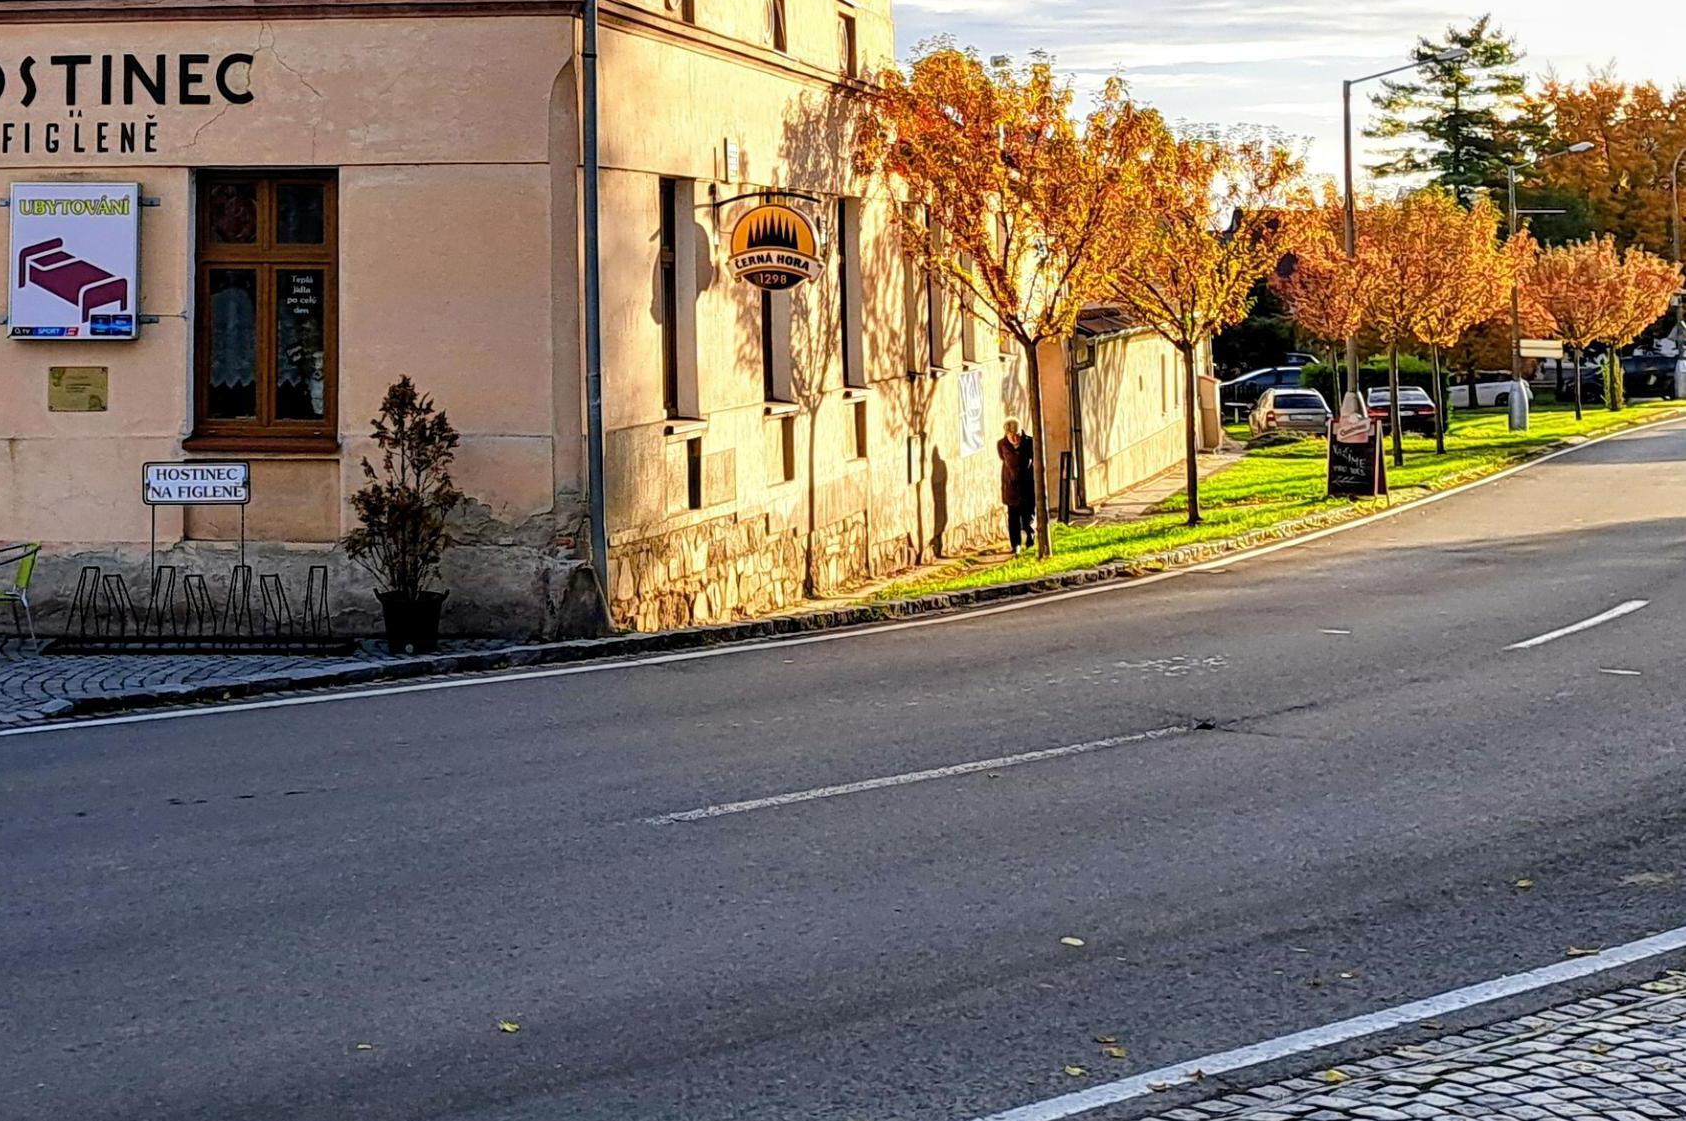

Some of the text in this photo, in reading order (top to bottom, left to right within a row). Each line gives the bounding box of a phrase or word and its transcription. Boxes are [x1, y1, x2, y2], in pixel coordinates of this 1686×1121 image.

[69, 109, 83, 118] NA
[2, 114, 158, 153] FIGLENĚ
[19, 193, 132, 216] UBYTOVÁNÍ
[734, 252, 810, 272] ČERNÁ HORA
[759, 273, 787, 284] 1298
[156, 468, 239, 480] HOSTINEC
[150, 482, 244, 498] NA FIGLENĚ
